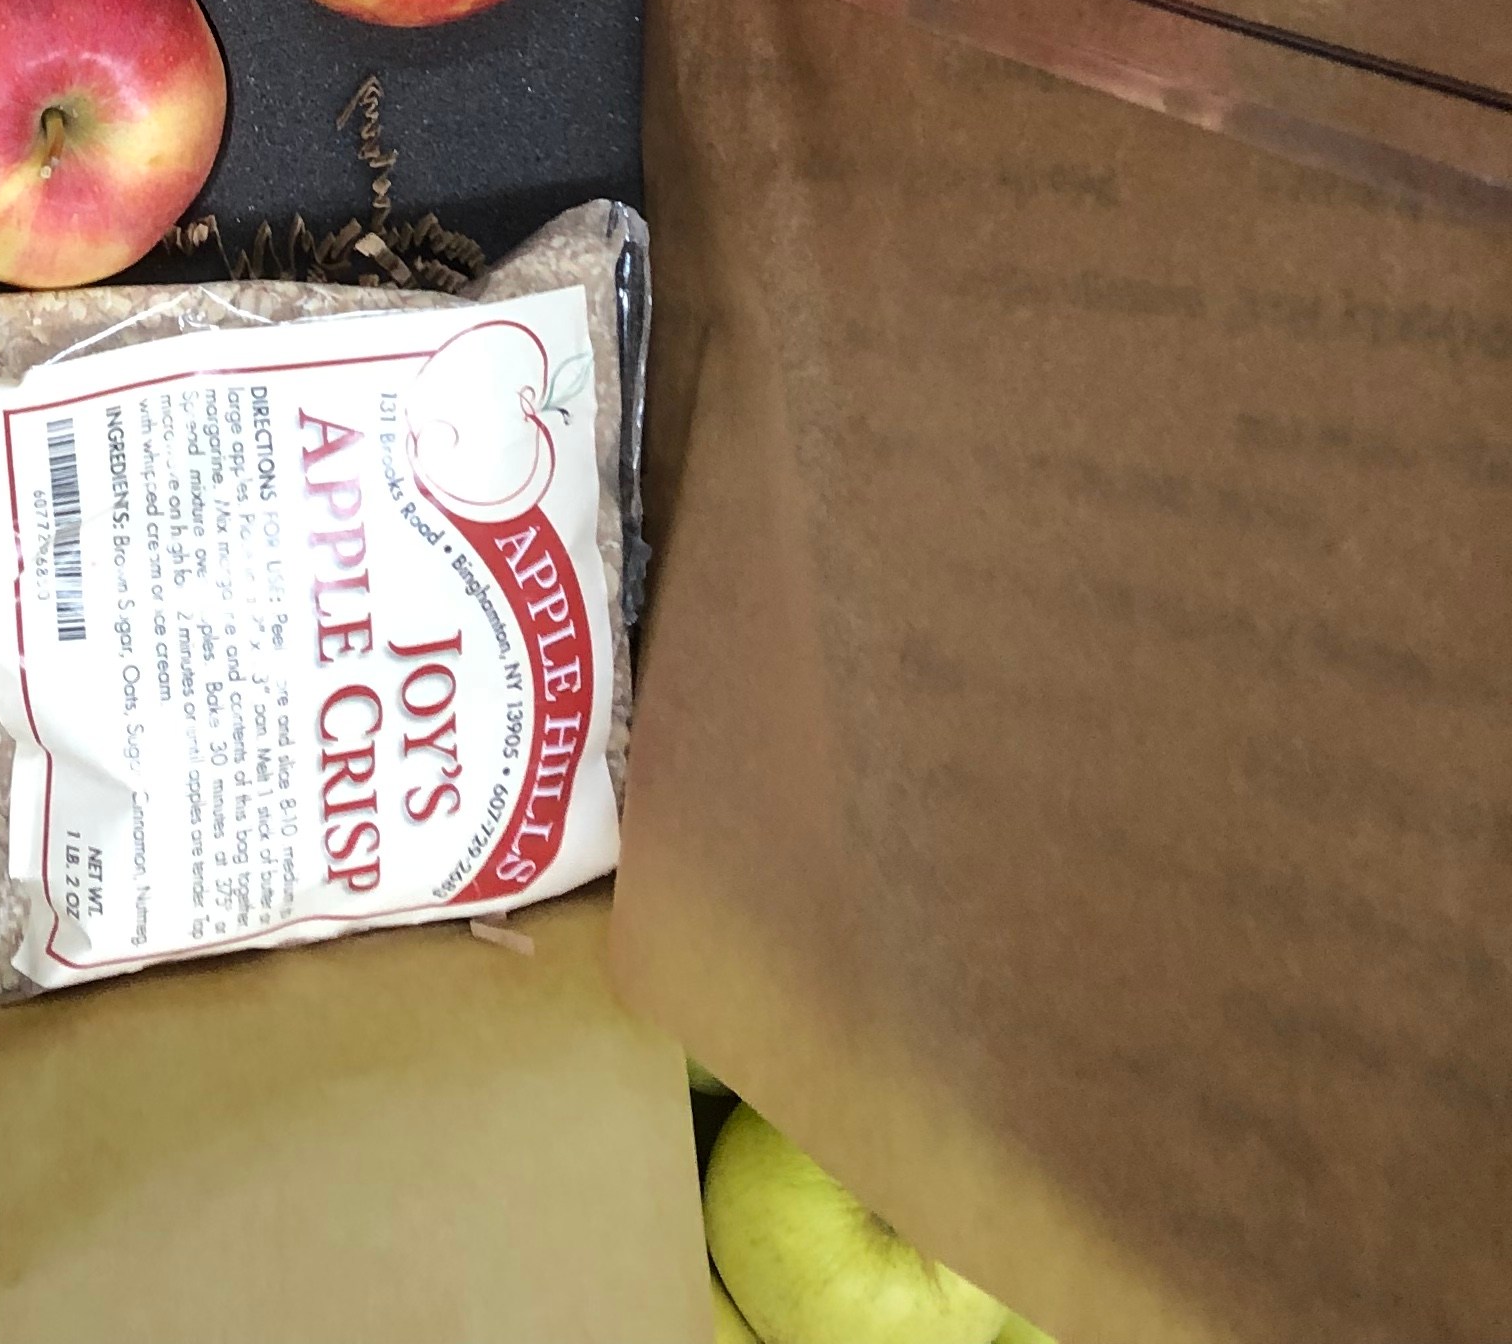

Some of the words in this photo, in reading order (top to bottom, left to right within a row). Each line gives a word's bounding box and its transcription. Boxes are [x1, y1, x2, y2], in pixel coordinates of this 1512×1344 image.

[203, 389, 224, 489] margarine.
[380, 393, 398, 422] 131
[250, 386, 277, 502] DIRECTIONS
[188, 469, 206, 537] mixture
[298, 407, 374, 663] APPLE
[399, 501, 445, 546] Road
[106, 406, 129, 529] INGREDIENTS:
[122, 665, 140, 716] Oats,
[451, 553, 511, 660] Binghamton,
[493, 525, 582, 702] APPLE
[503, 662, 523, 691] NY
[387, 629, 463, 822] JOY'S
[503, 700, 523, 759] 13905
[319, 684, 383, 893] CRISP
[495, 711, 582, 883] HILLS
[66, 845, 80, 868] LB.
[66, 875, 80, 887] 2
[88, 846, 103, 881] NET
[66, 892, 80, 920] OZ
[88, 887, 103, 917] WT.
